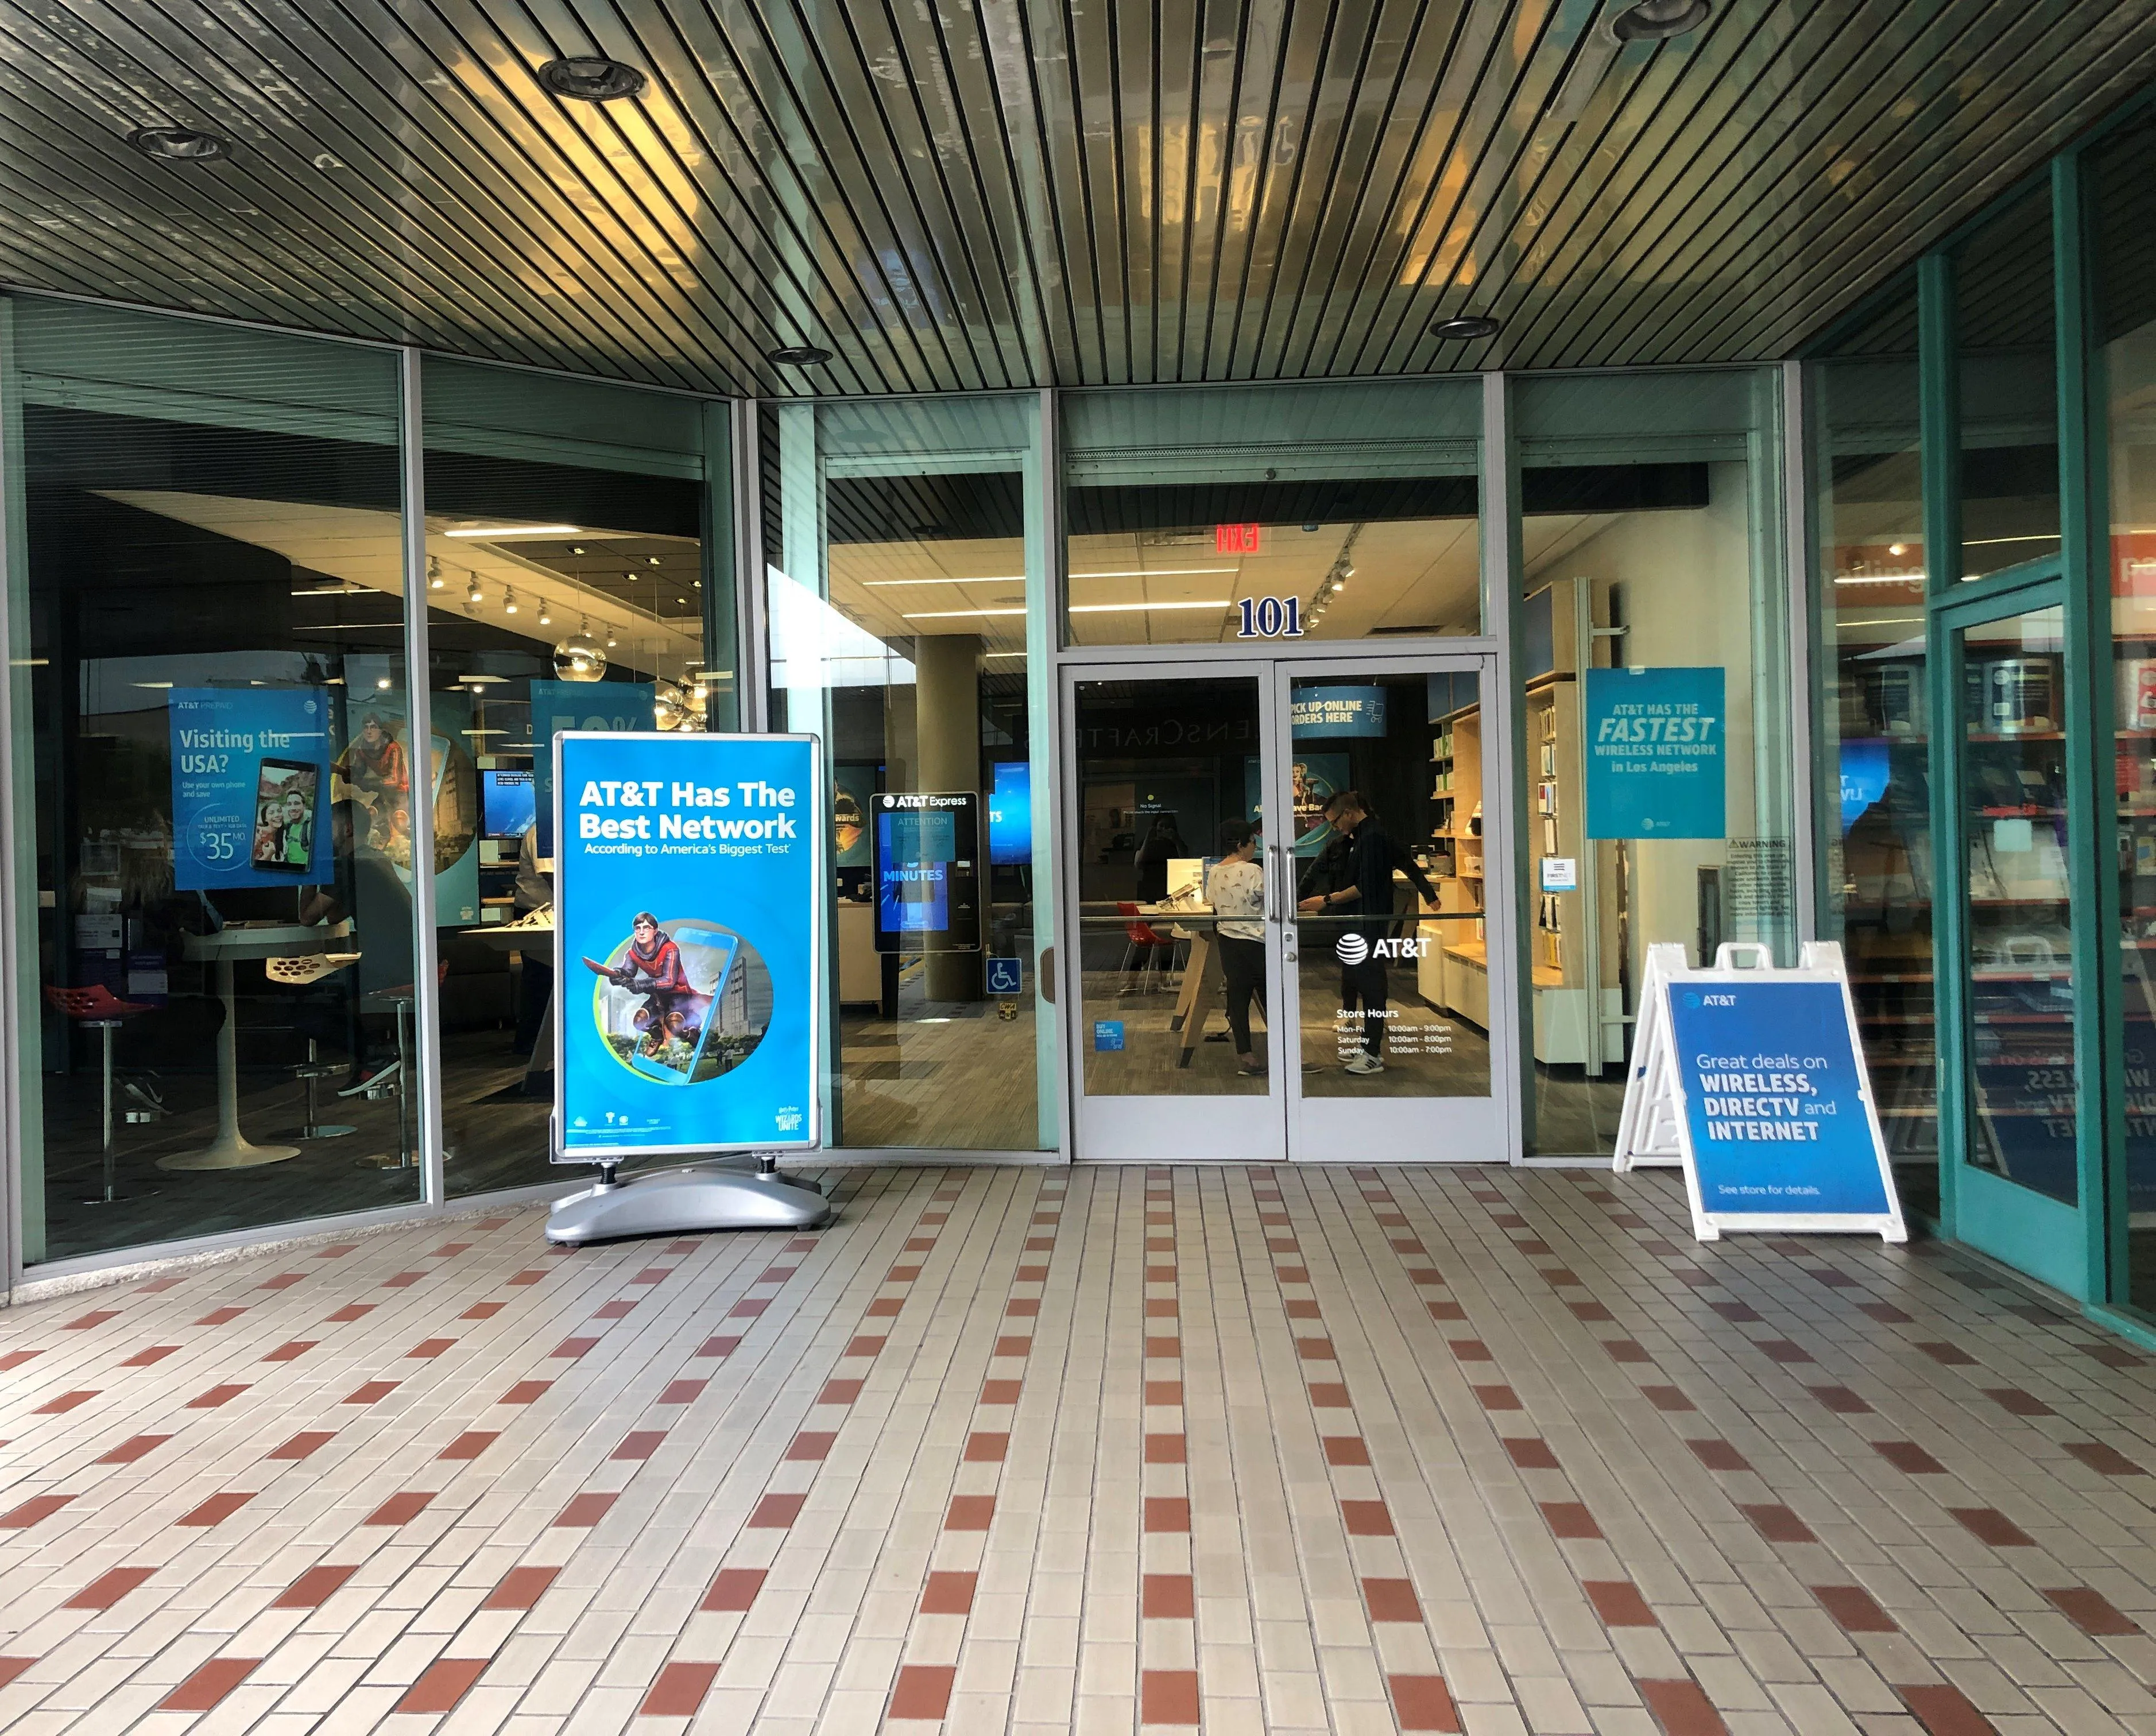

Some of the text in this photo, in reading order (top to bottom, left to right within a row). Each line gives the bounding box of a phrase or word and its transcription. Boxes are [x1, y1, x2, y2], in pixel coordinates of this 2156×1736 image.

[1237, 595, 1304, 638] 101
[1324, 700, 1363, 712] ONLINE
[1613, 703, 1698, 715] AT&T HAS THE
[1326, 712, 1353, 723] HERE
[1597, 717, 1715, 742] FASTEST
[180, 728, 290, 753] Visiting the
[1594, 745, 1716, 756] WIRELESS NETWORK
[181, 754, 229, 773] USA?
[1612, 760, 1698, 775] in Los Angeles
[226, 781, 246, 789] phone
[579, 781, 663, 807] AT&T
[672, 782, 730, 807] Has
[737, 781, 795, 807] The
[896, 795, 966, 808] AT&T Express
[579, 813, 797, 839] Best Network
[898, 817, 947, 826] ATTENTION
[584, 843, 642, 857] According
[645, 844, 658, 854] to
[719, 844, 762, 857] Biggest
[1739, 840, 1786, 848] WARNING
[883, 870, 943, 882] MINUTES
[1372, 938, 1432, 958] AT&T
[1703, 994, 1736, 1006] AT&T
[1337, 1009, 1399, 1018] Store Hours
[1388, 1025, 1418, 1033] 10:00am
[1424, 1025, 1451, 1033] 9:00pm
[1337, 1036, 1370, 1044] Saturday
[1389, 1036, 1419, 1044] 10:00am
[1424, 1035, 1451, 1044] 8:00pm
[1337, 1047, 1365, 1055] Sunday
[1389, 1046, 1419, 1054] 10:00am
[1697, 1053, 1828, 1069] Great deals on
[1699, 1073, 1818, 1096] WIRELESS,
[1704, 1097, 1837, 1117] DIRECTV and
[778, 1121, 799, 1132] UNITE
[1707, 1121, 1818, 1141] INTERNET
[1718, 1185, 1737, 1195] See
[1740, 1185, 1766, 1195] store
[1768, 1185, 1783, 1195] for
